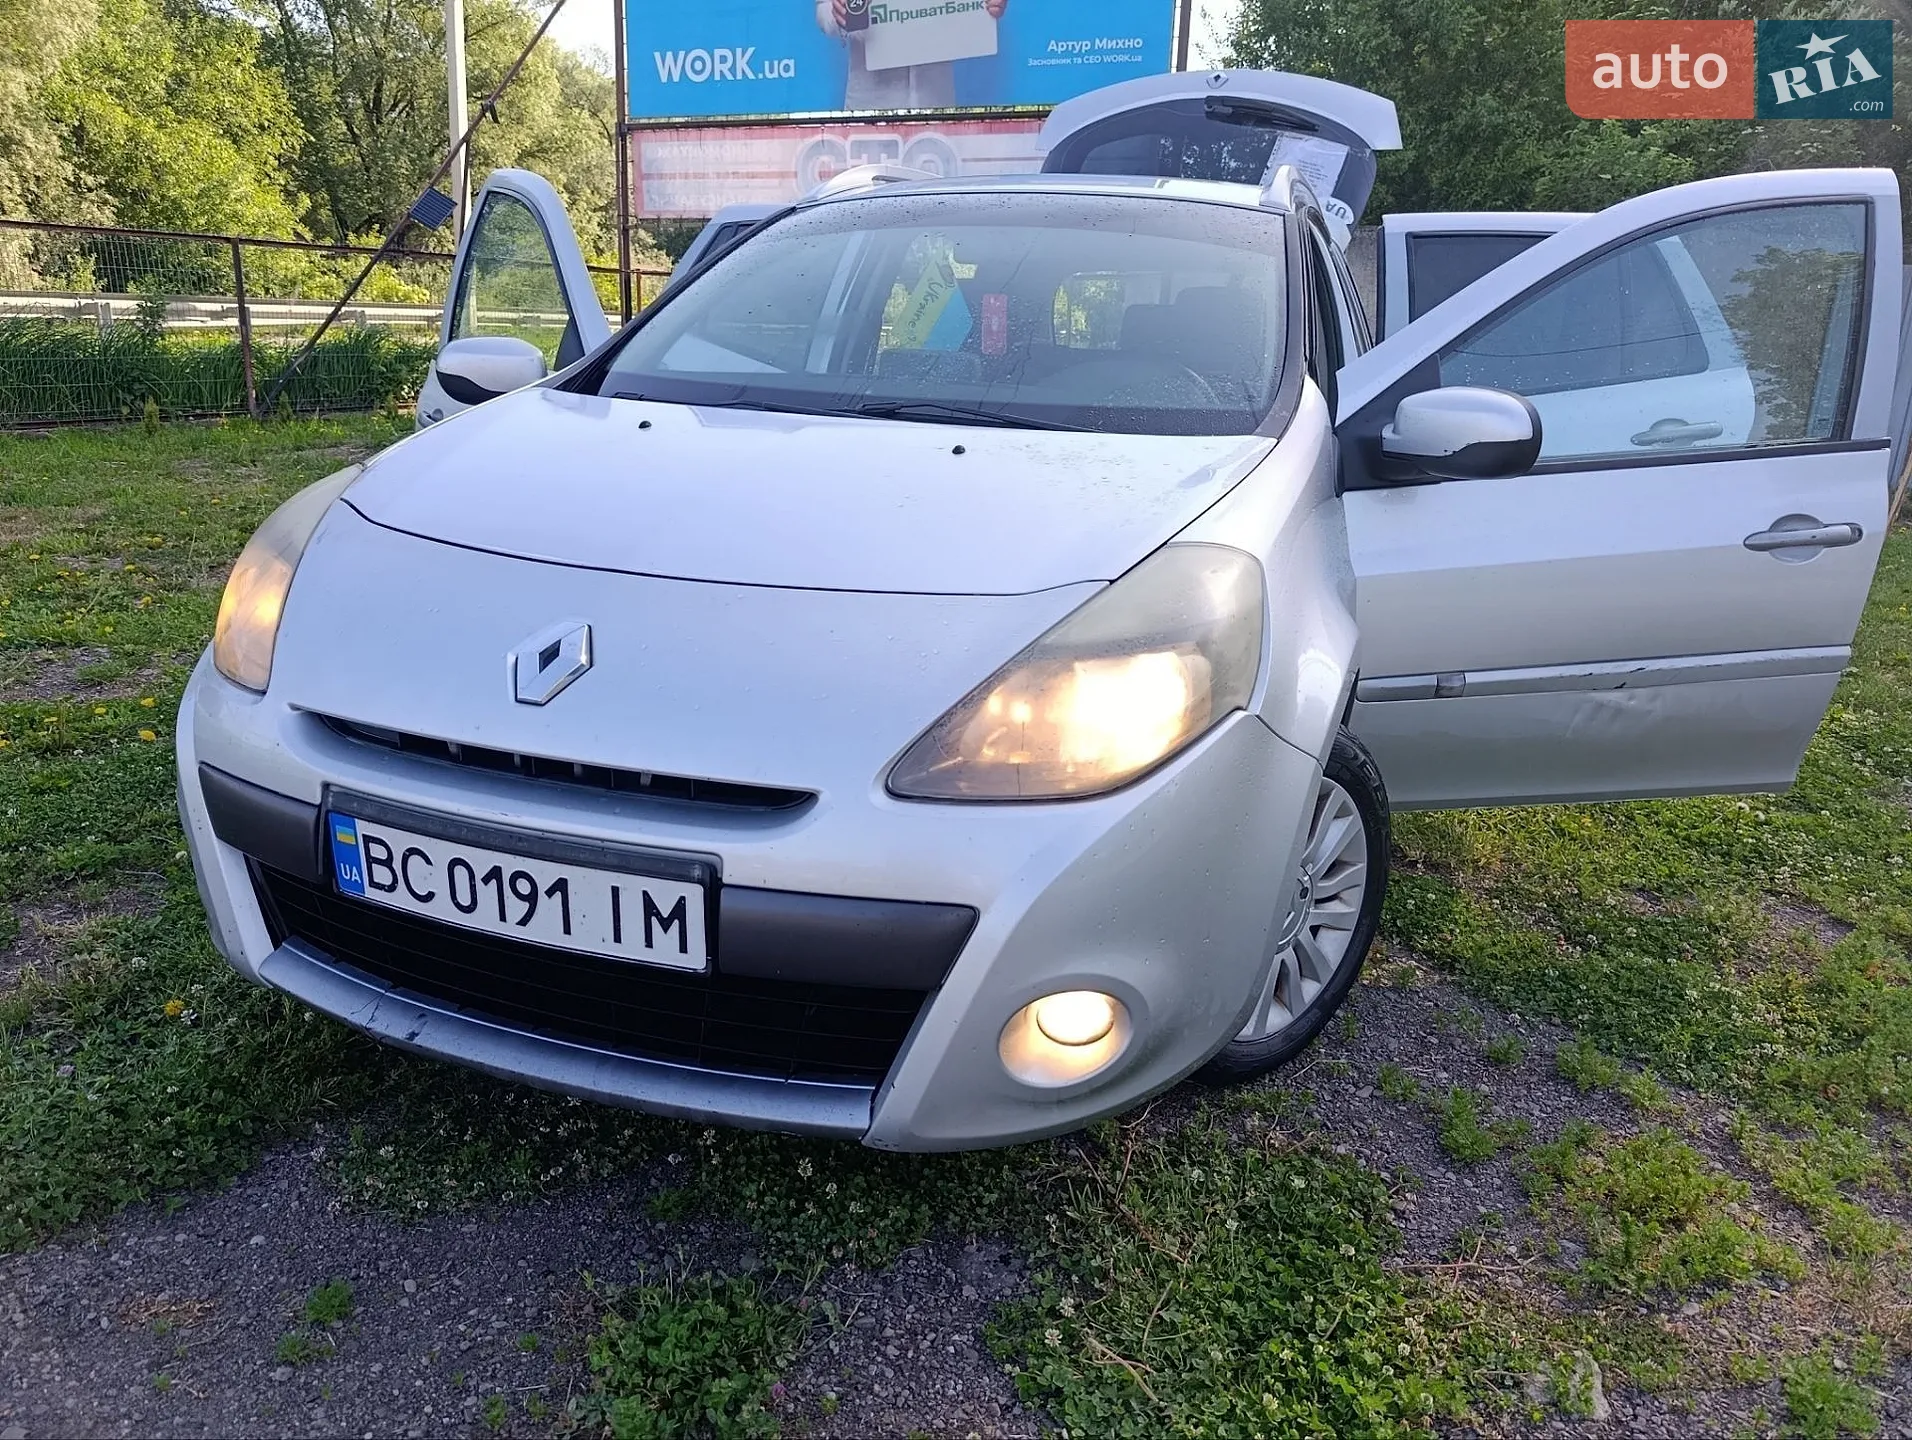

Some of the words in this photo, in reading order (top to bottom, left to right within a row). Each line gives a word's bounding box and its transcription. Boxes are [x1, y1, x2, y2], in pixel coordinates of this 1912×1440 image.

[889, 1, 984, 23] ПриватБанк
[1047, 40, 1091, 54] Артур
[1095, 38, 1143, 49] Михно
[653, 47, 796, 83] WORK.ua
[1028, 58, 1072, 66] Засновник
[1083, 55, 1101, 64] CEO
[1103, 54, 1143, 63] WORK.ua
[340, 865, 361, 884] UA
